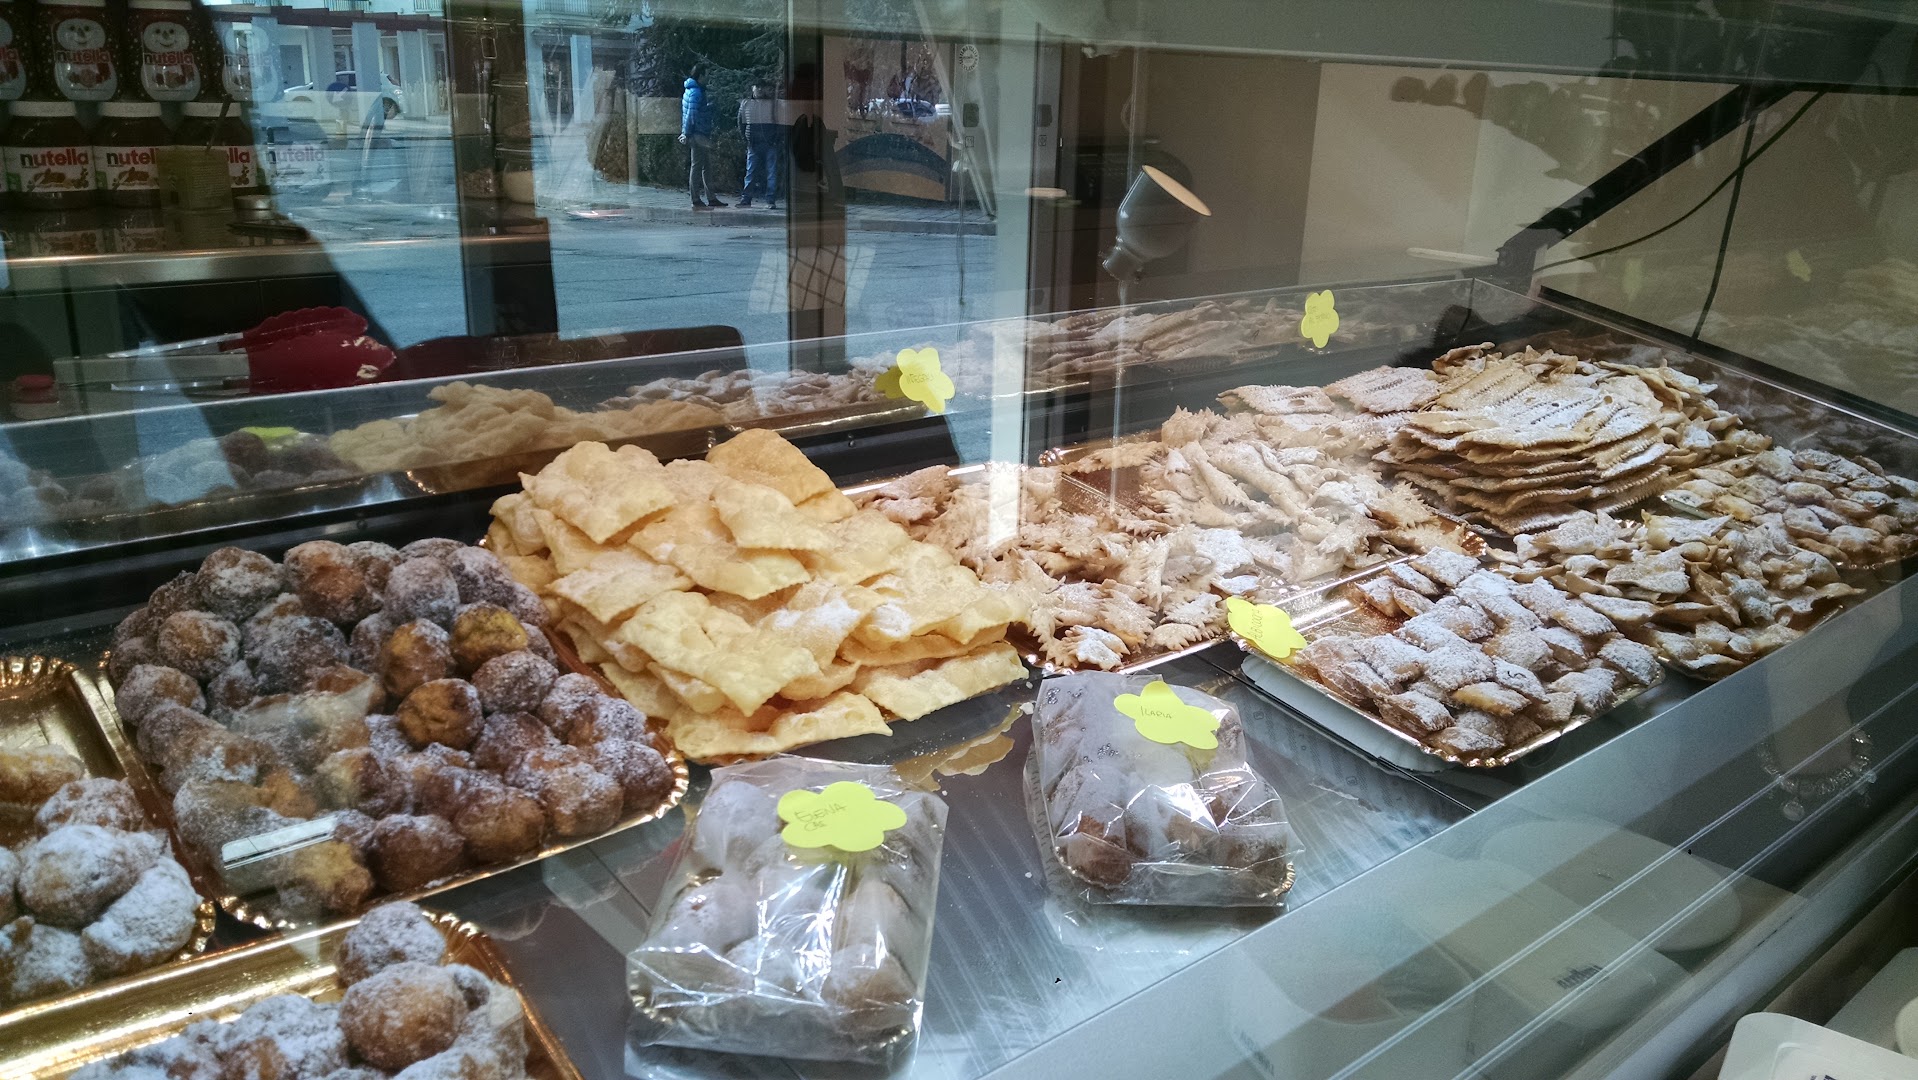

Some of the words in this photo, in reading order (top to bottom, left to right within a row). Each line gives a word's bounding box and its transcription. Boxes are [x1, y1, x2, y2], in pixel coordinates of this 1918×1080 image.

[55, 49, 110, 64] nutella
[143, 51, 194, 65] nutella
[20, 147, 89, 166] nutella
[267, 146, 325, 165] nutella
